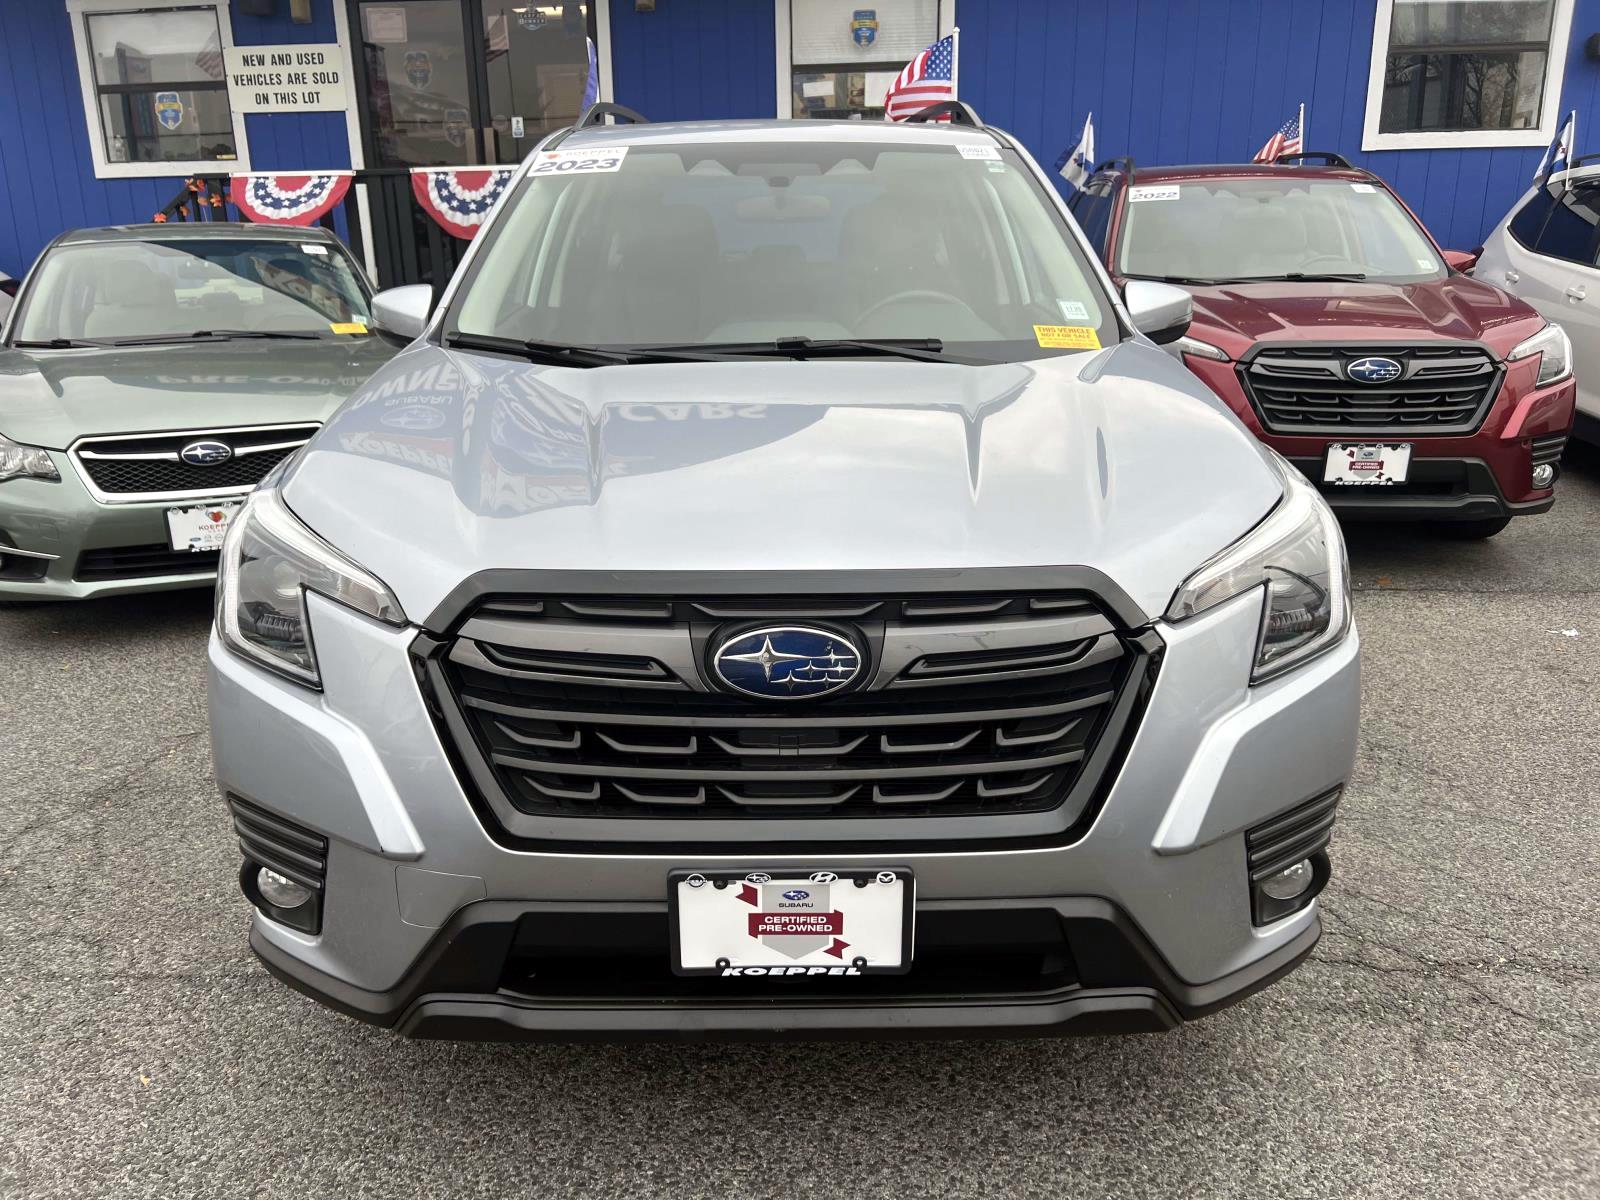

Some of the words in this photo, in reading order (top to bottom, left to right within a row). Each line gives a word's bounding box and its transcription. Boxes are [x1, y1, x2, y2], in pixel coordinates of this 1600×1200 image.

[242, 54, 265, 67] NEW
[271, 53, 292, 66] AND
[296, 52, 324, 65] USED
[233, 73, 282, 86] VEHICLES
[287, 72, 308, 85] ARE
[312, 72, 339, 84] SOLD
[255, 93, 269, 105] ON
[273, 92, 298, 104] THIS
[302, 91, 320, 104] LOT
[533, 158, 620, 173] 2023
[1131, 191, 1178, 200] 2022
[1057, 326, 1091, 334] VEHICLE
[764, 916, 827, 924] CERTIFIED
[758, 924, 833, 932] PRE-OWNED
[721, 967, 862, 977] KOEPPEL
